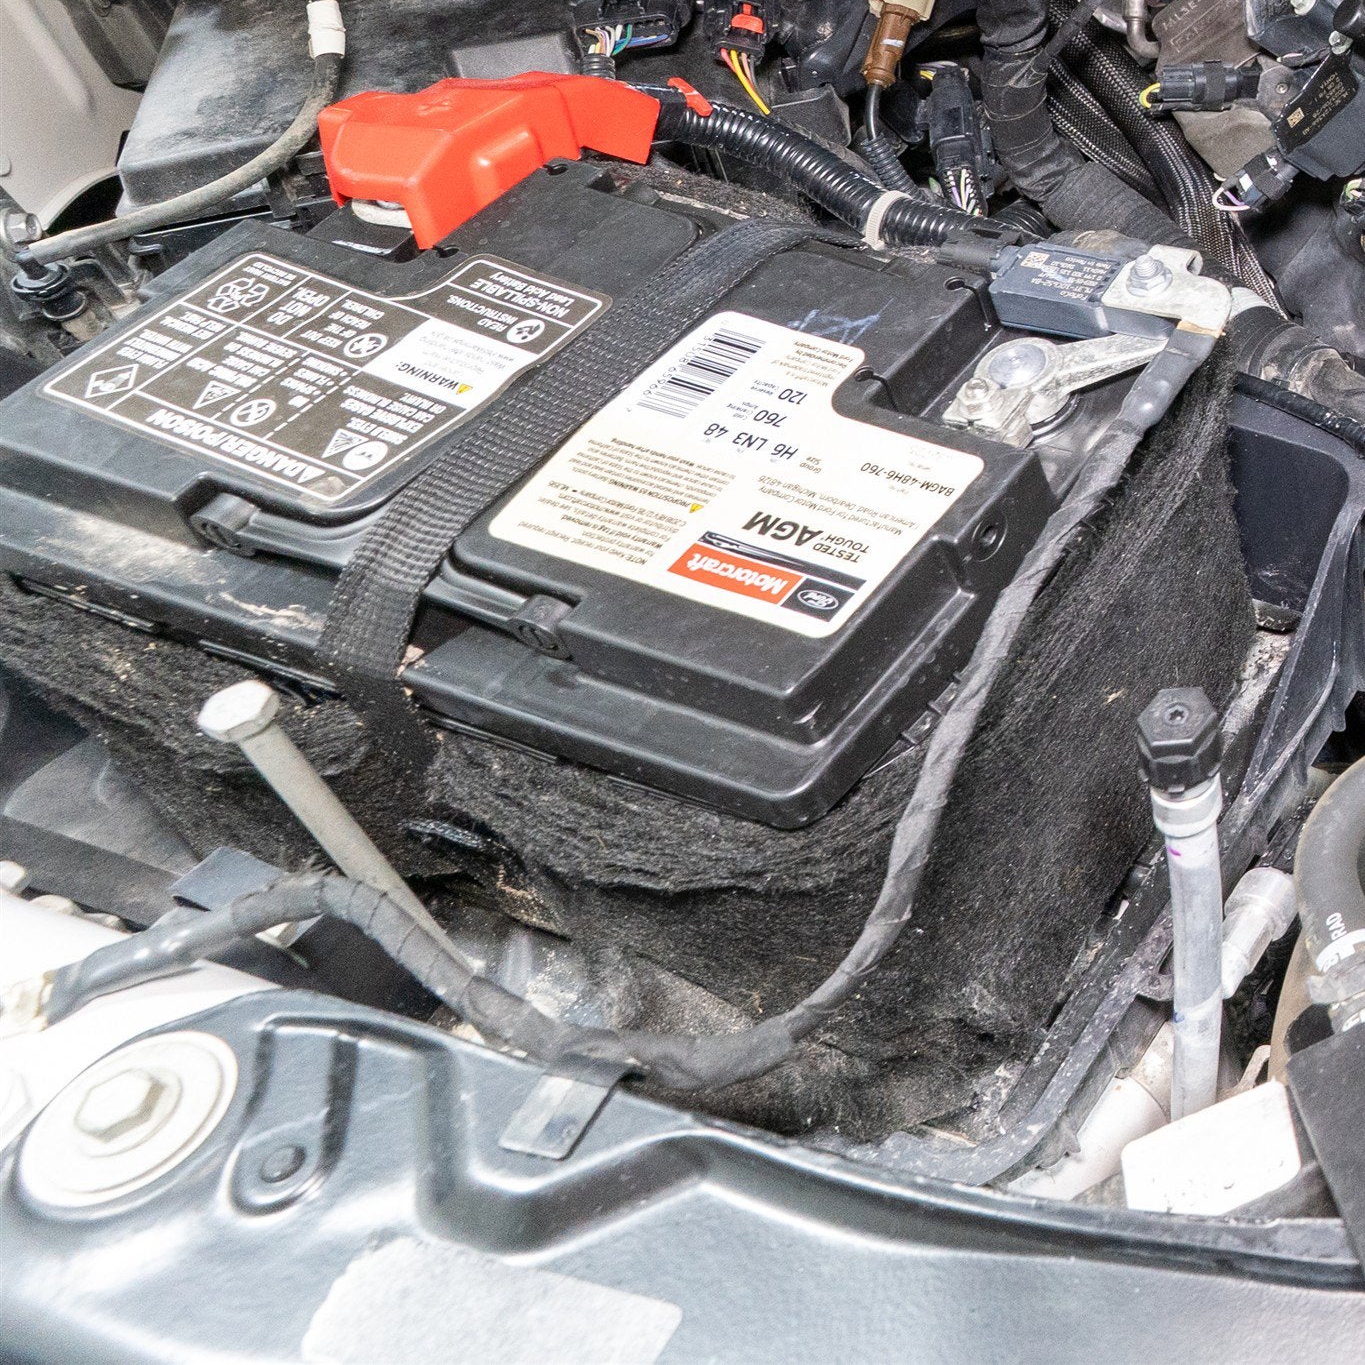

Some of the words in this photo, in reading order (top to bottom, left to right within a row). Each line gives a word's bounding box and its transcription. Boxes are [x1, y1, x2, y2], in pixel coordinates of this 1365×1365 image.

[486, 271, 531, 290] Battery
[286, 286, 333, 307] OPEN.
[467, 278, 572, 317] NON-SPILLABLE
[522, 284, 551, 297] Acid
[545, 291, 577, 306] Lead
[277, 299, 315, 317] NOT
[441, 294, 520, 324] INSTRUCTIONS.
[264, 310, 294, 325] DO
[475, 317, 509, 332] READ
[390, 360, 461, 389] WARNING:
[776, 387, 808, 405] 120
[343, 415, 378, 433] EYES.
[751, 408, 788, 427] 760
[701, 422, 730, 439] 48
[143, 407, 309, 478] DANGER/POISON
[634, 445, 650, 453] after
[731, 431, 768, 450] LN3
[648, 449, 667, 458] hands
[768, 442, 798, 460] H6
[678, 459, 695, 467] Wash
[757, 474, 784, 486] 48126
[858, 461, 955, 496] BAGM-48H6-760
[757, 484, 798, 501] Company
[780, 480, 819, 497] Michigan
[646, 490, 690, 507] PROPOSITION
[793, 496, 819, 508] Motor
[816, 504, 837, 514] Ford
[835, 510, 849, 518] for
[596, 524, 612, 533] tag
[847, 513, 903, 535] Manufactured
[877, 512, 916, 528] American
[614, 530, 631, 539] void
[741, 510, 824, 548] AGM
[629, 534, 664, 549] Warranty
[624, 554, 647, 564] NOTE:
[811, 542, 862, 563] TESTED
[682, 552, 788, 595] Motorcraft
[803, 591, 832, 608] Ford
[1326, 912, 1347, 941] RAD
